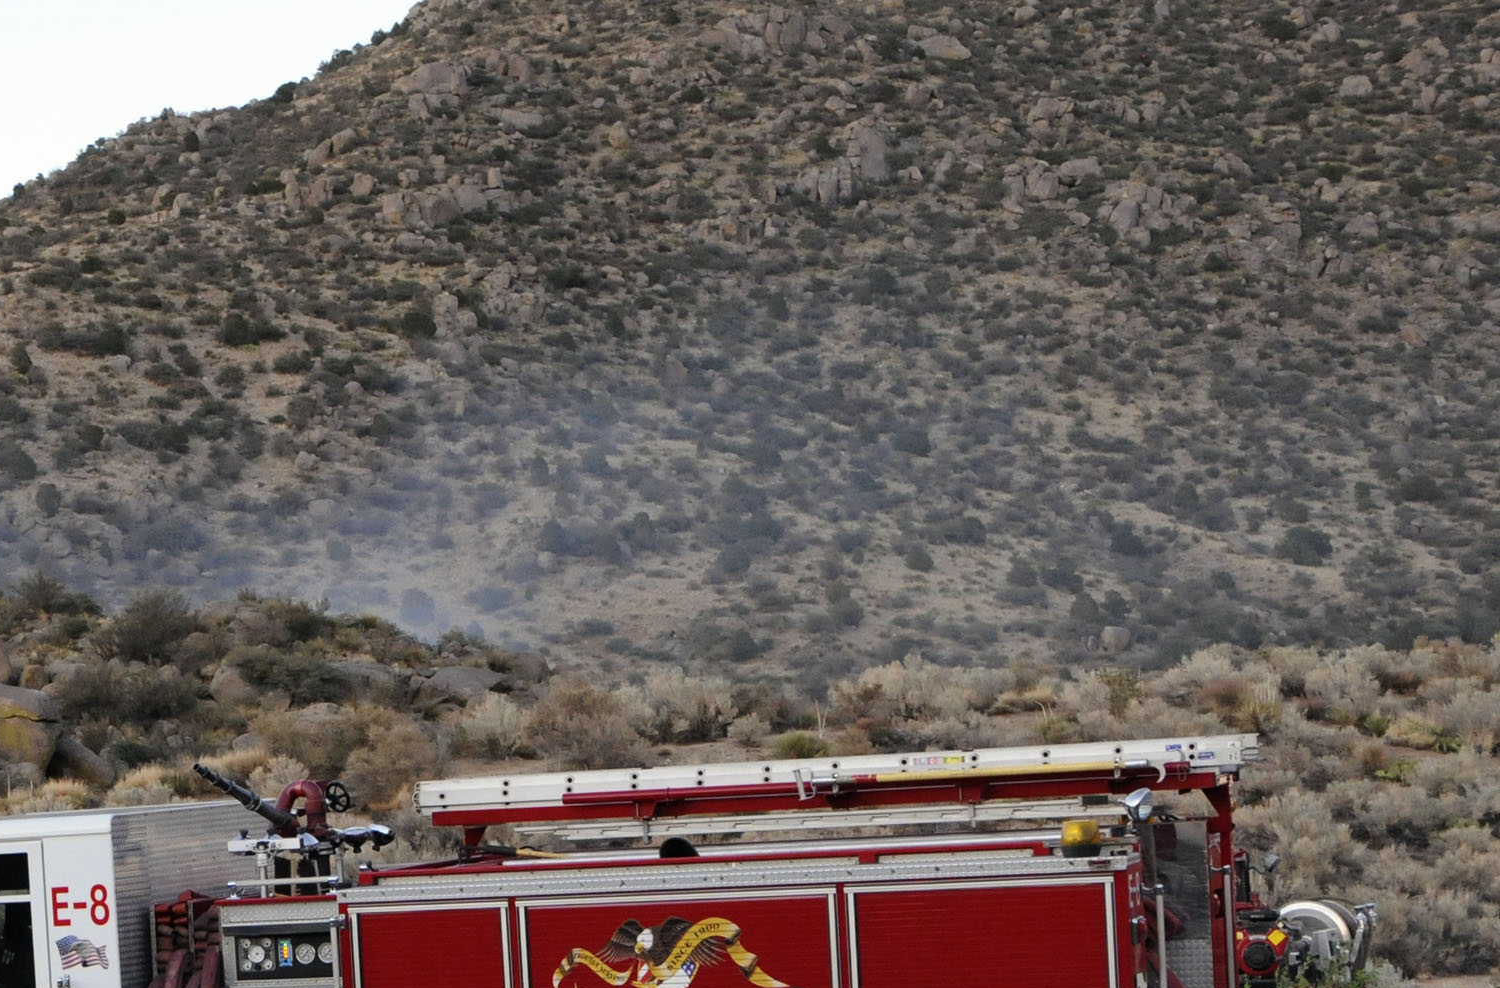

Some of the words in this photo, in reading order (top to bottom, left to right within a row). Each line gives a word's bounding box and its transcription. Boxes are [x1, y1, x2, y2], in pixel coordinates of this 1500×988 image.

[51, 884, 110, 927] E-8
[666, 939, 693, 971] SINCE
[694, 922, 721, 938] 1900
